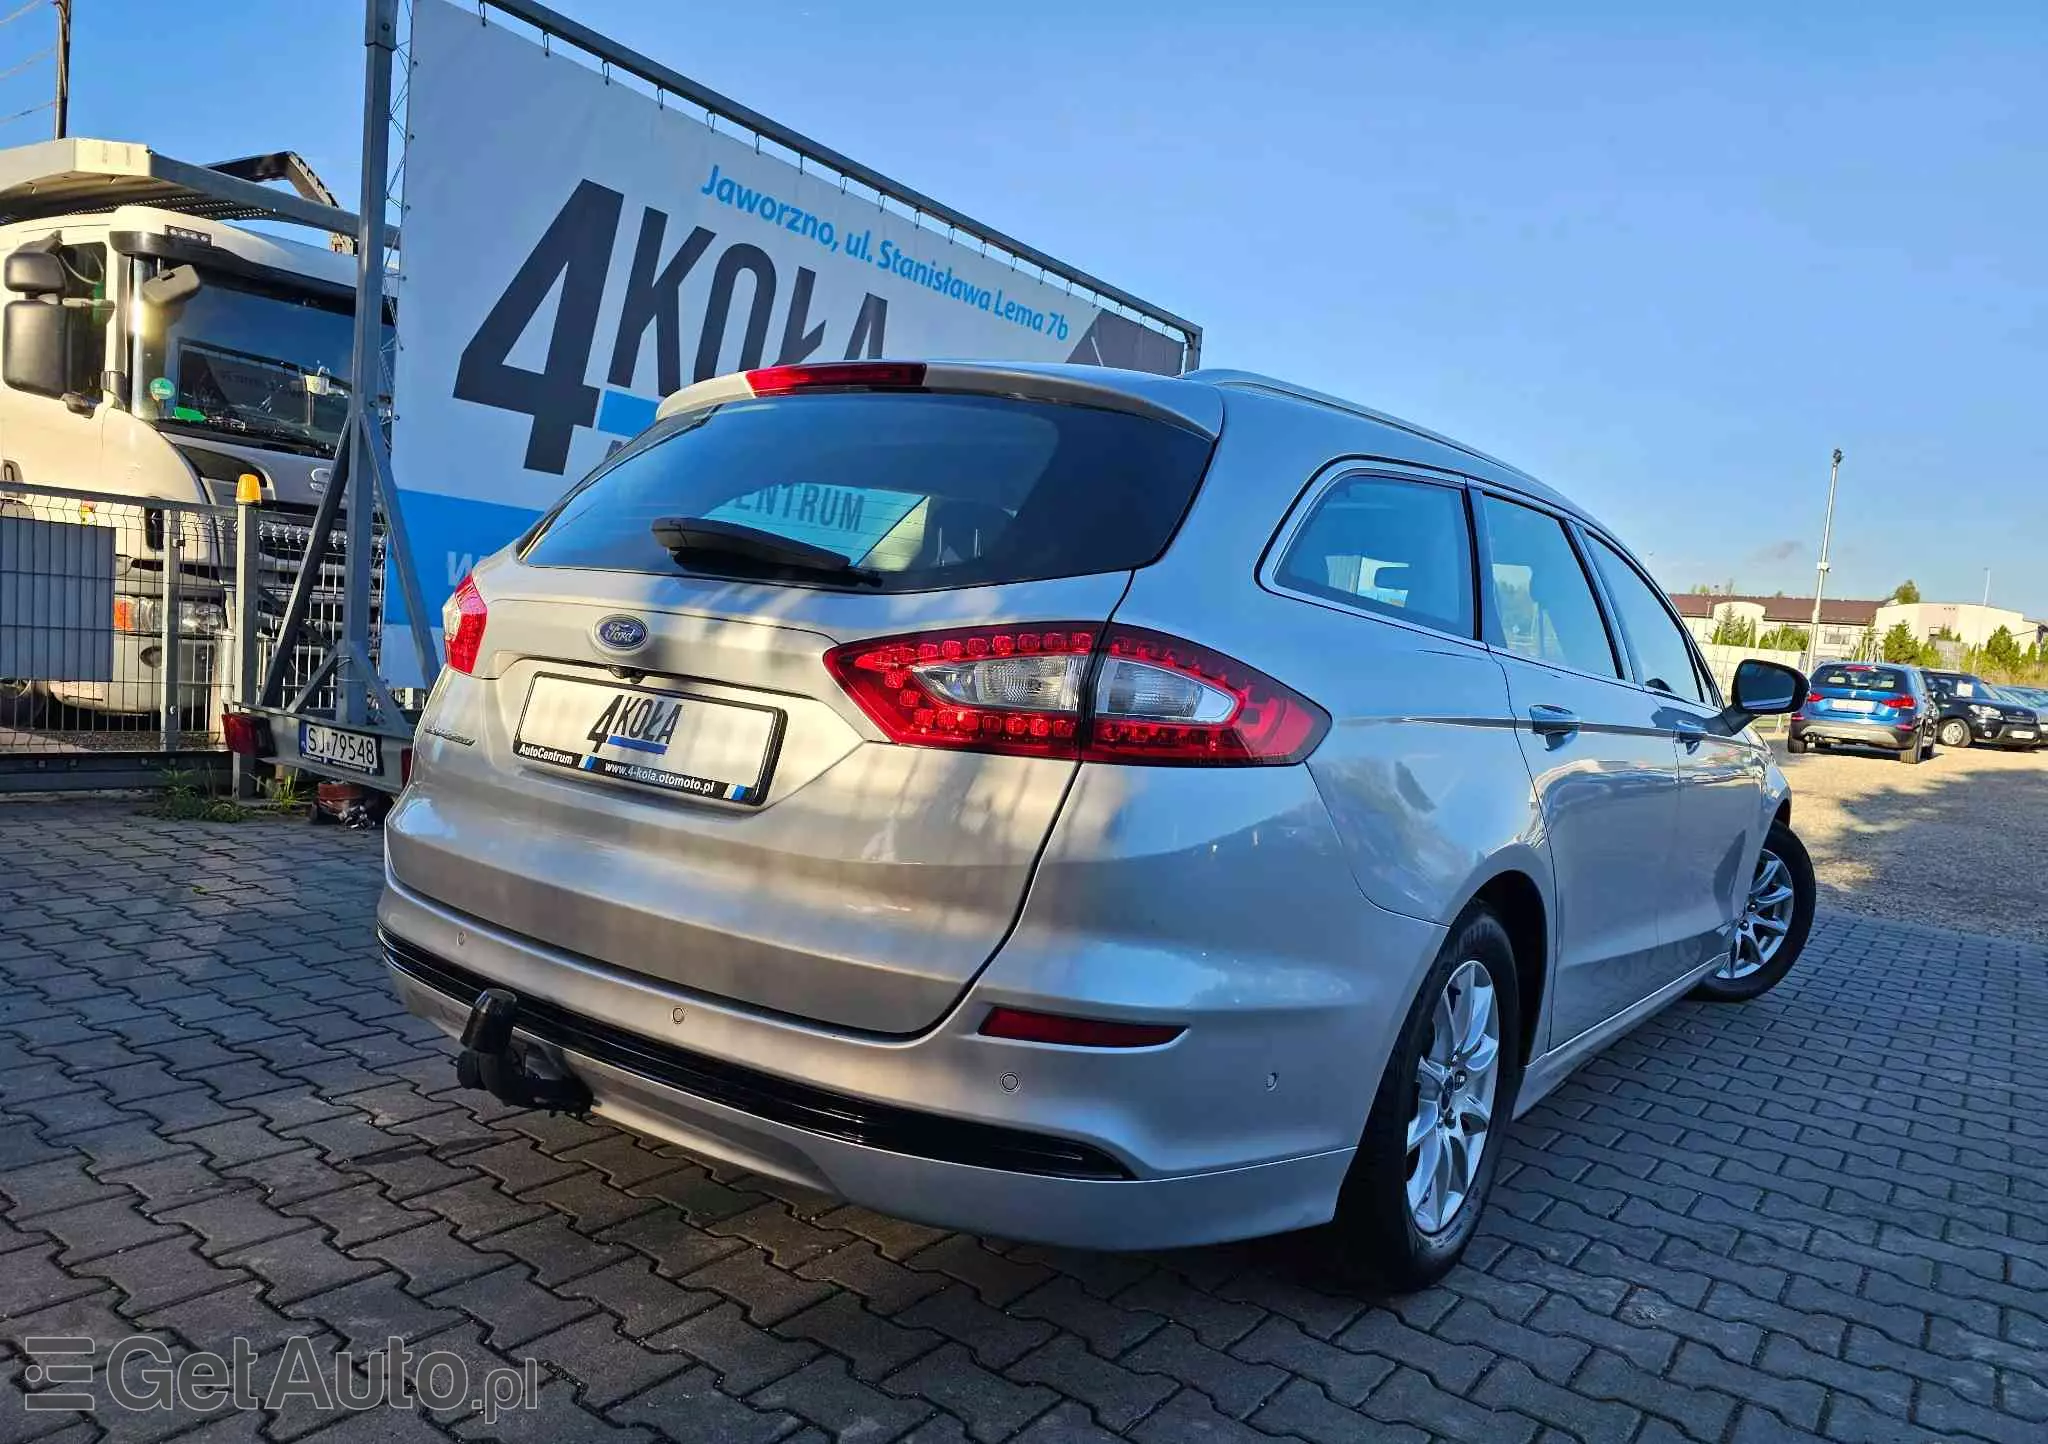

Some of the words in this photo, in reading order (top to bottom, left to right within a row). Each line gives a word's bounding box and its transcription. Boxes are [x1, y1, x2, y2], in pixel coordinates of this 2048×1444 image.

[702, 165, 839, 252] Jaworzno,
[845, 230, 873, 262] ul.
[877, 239, 990, 311] Stanisława
[994, 289, 1044, 331] Lema
[1046, 311, 1069, 341] 7b
[587, 694, 684, 752] 4KOŁA
[331, 732, 376, 765] 79548
[519, 743, 573, 765] AutoCentrum
